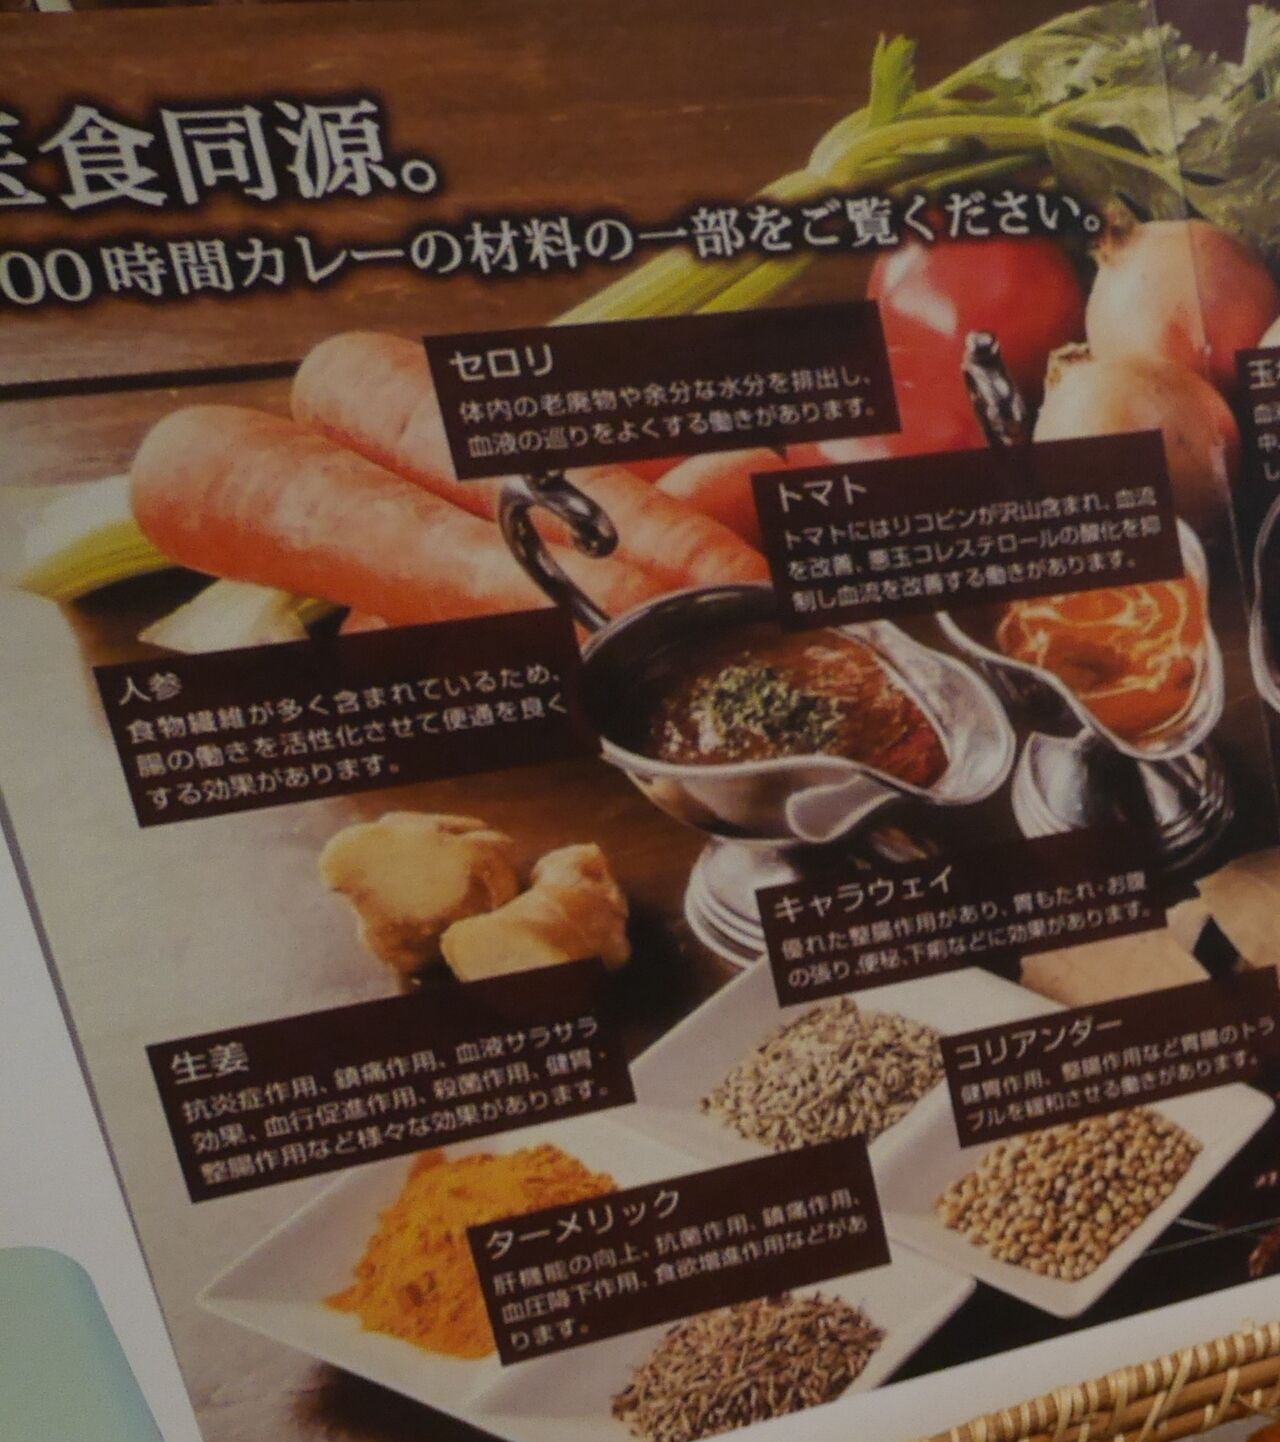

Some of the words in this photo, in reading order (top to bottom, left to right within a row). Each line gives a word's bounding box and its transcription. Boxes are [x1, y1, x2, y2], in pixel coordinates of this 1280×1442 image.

[449, 343, 554, 382] セロリ
[459, 367, 872, 425] 体内の老廃物や余分な水分を排出し、
[467, 397, 876, 458] 血液の巡りをよくする働きがあります。
[778, 475, 867, 513] トマト
[119, 671, 182, 706] 人参
[127, 664, 560, 744] 食物繊維が多く含まれているため、
[136, 694, 567, 778] 腸の働きを活性化させて便通を良く
[146, 753, 400, 811] する効果があります。
[774, 864, 952, 925] キャラウェイ
[170, 1041, 249, 1085] 生姜
[955, 1016, 1123, 1071] コリアンダー
[200, 1081, 609, 1184] 整腸作用など様々な効果があります。
[486, 1189, 679, 1260] ターメリック
[509, 1317, 589, 1351] ります。
